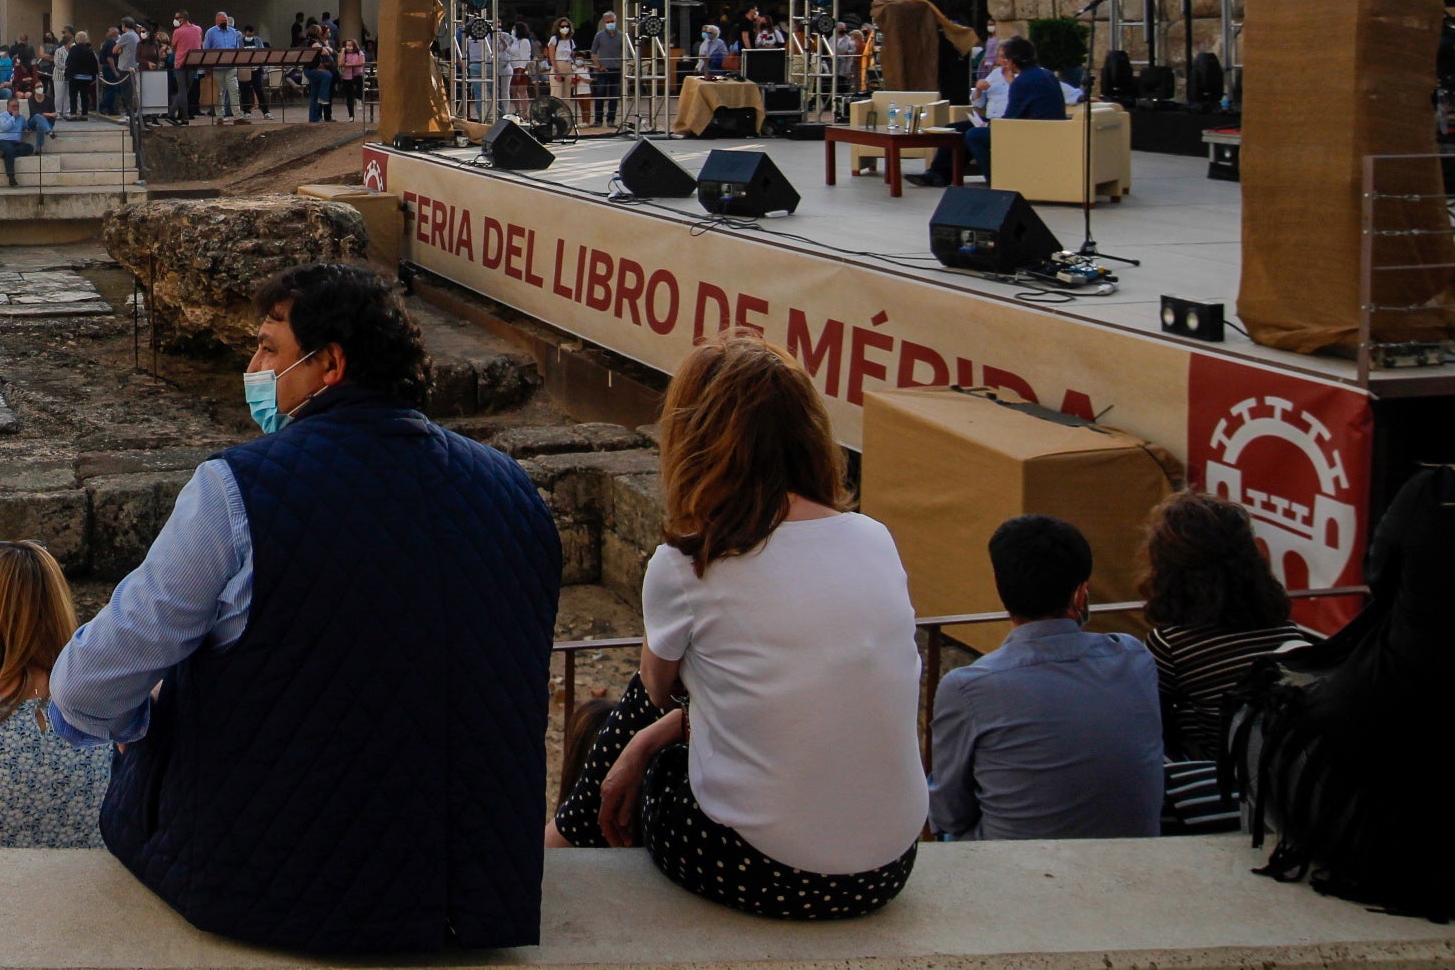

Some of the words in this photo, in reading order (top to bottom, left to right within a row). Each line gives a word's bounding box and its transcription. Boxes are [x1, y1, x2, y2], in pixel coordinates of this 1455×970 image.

[403, 190, 475, 262] FERIA
[482, 216, 544, 288] DEL
[553, 238, 680, 336] LIBRO
